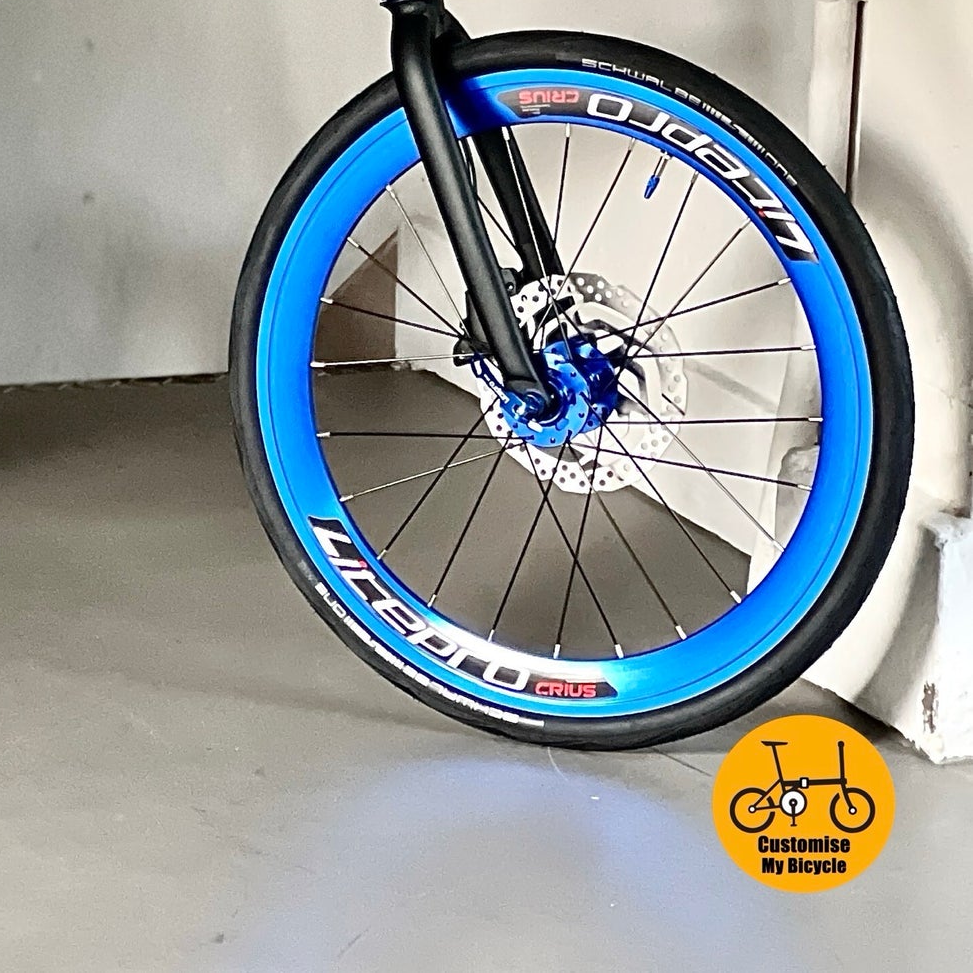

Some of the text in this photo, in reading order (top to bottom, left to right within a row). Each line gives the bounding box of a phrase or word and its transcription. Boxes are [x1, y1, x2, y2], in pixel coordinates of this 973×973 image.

[581, 58, 702, 105] SCHWALBE
[518, 90, 580, 105] CRIUS
[534, 681, 598, 698] CRIUS
